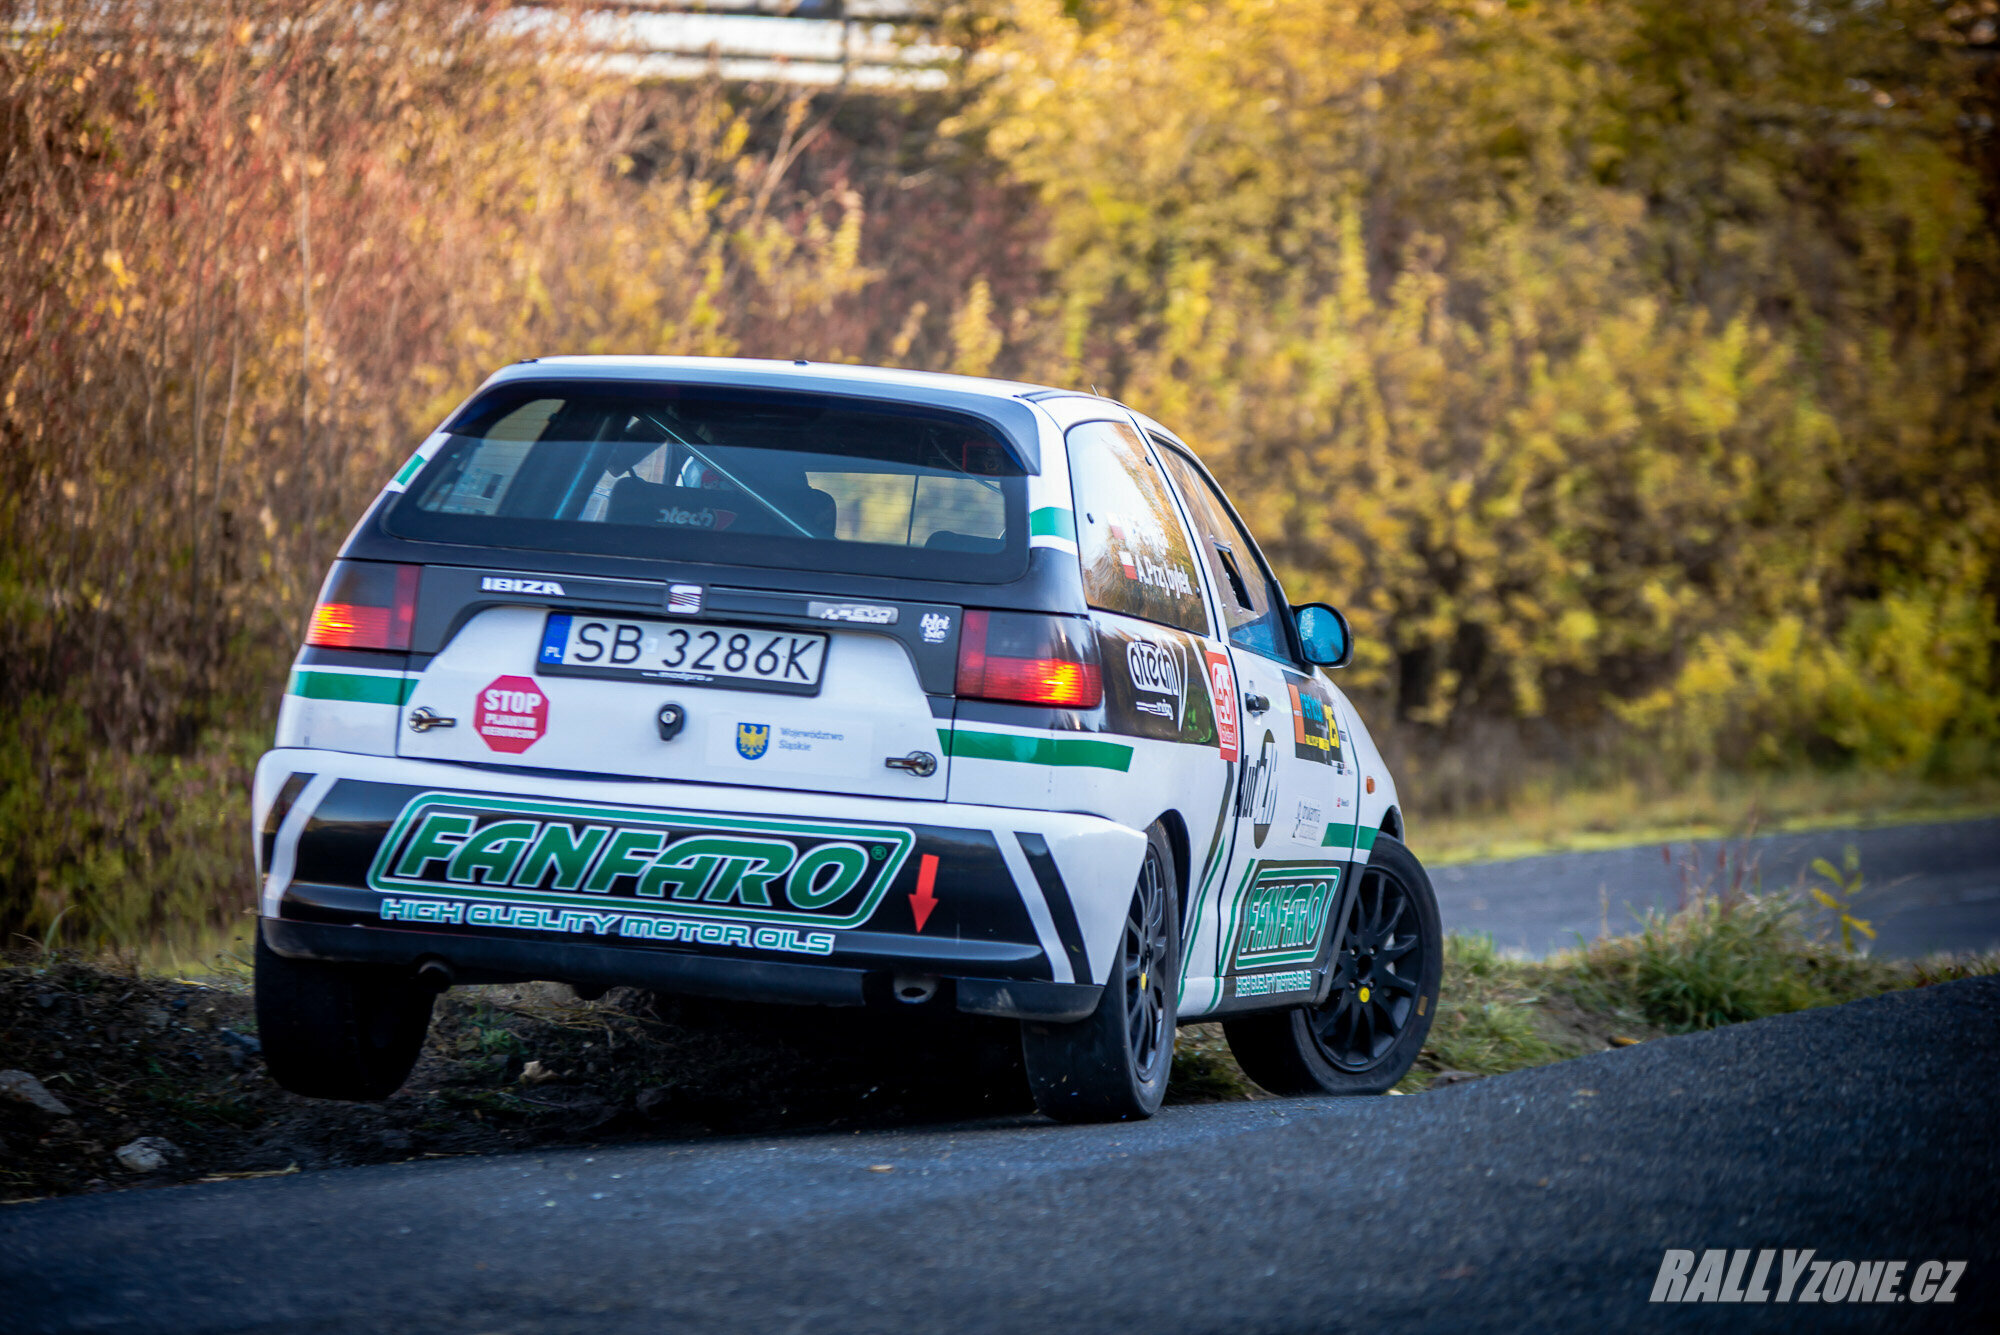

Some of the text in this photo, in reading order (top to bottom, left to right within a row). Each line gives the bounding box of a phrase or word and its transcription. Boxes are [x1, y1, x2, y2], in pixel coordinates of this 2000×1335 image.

[481, 577, 566, 596] IBIZA
[545, 646, 562, 658] PL
[574, 622, 818, 681] SB 3286K
[483, 688, 542, 714] STOP
[394, 811, 870, 910] FANFARO
[380, 898, 836, 956] HIGH QUALITY MOTOR OILS
[1242, 881, 1327, 953] FANFARO
